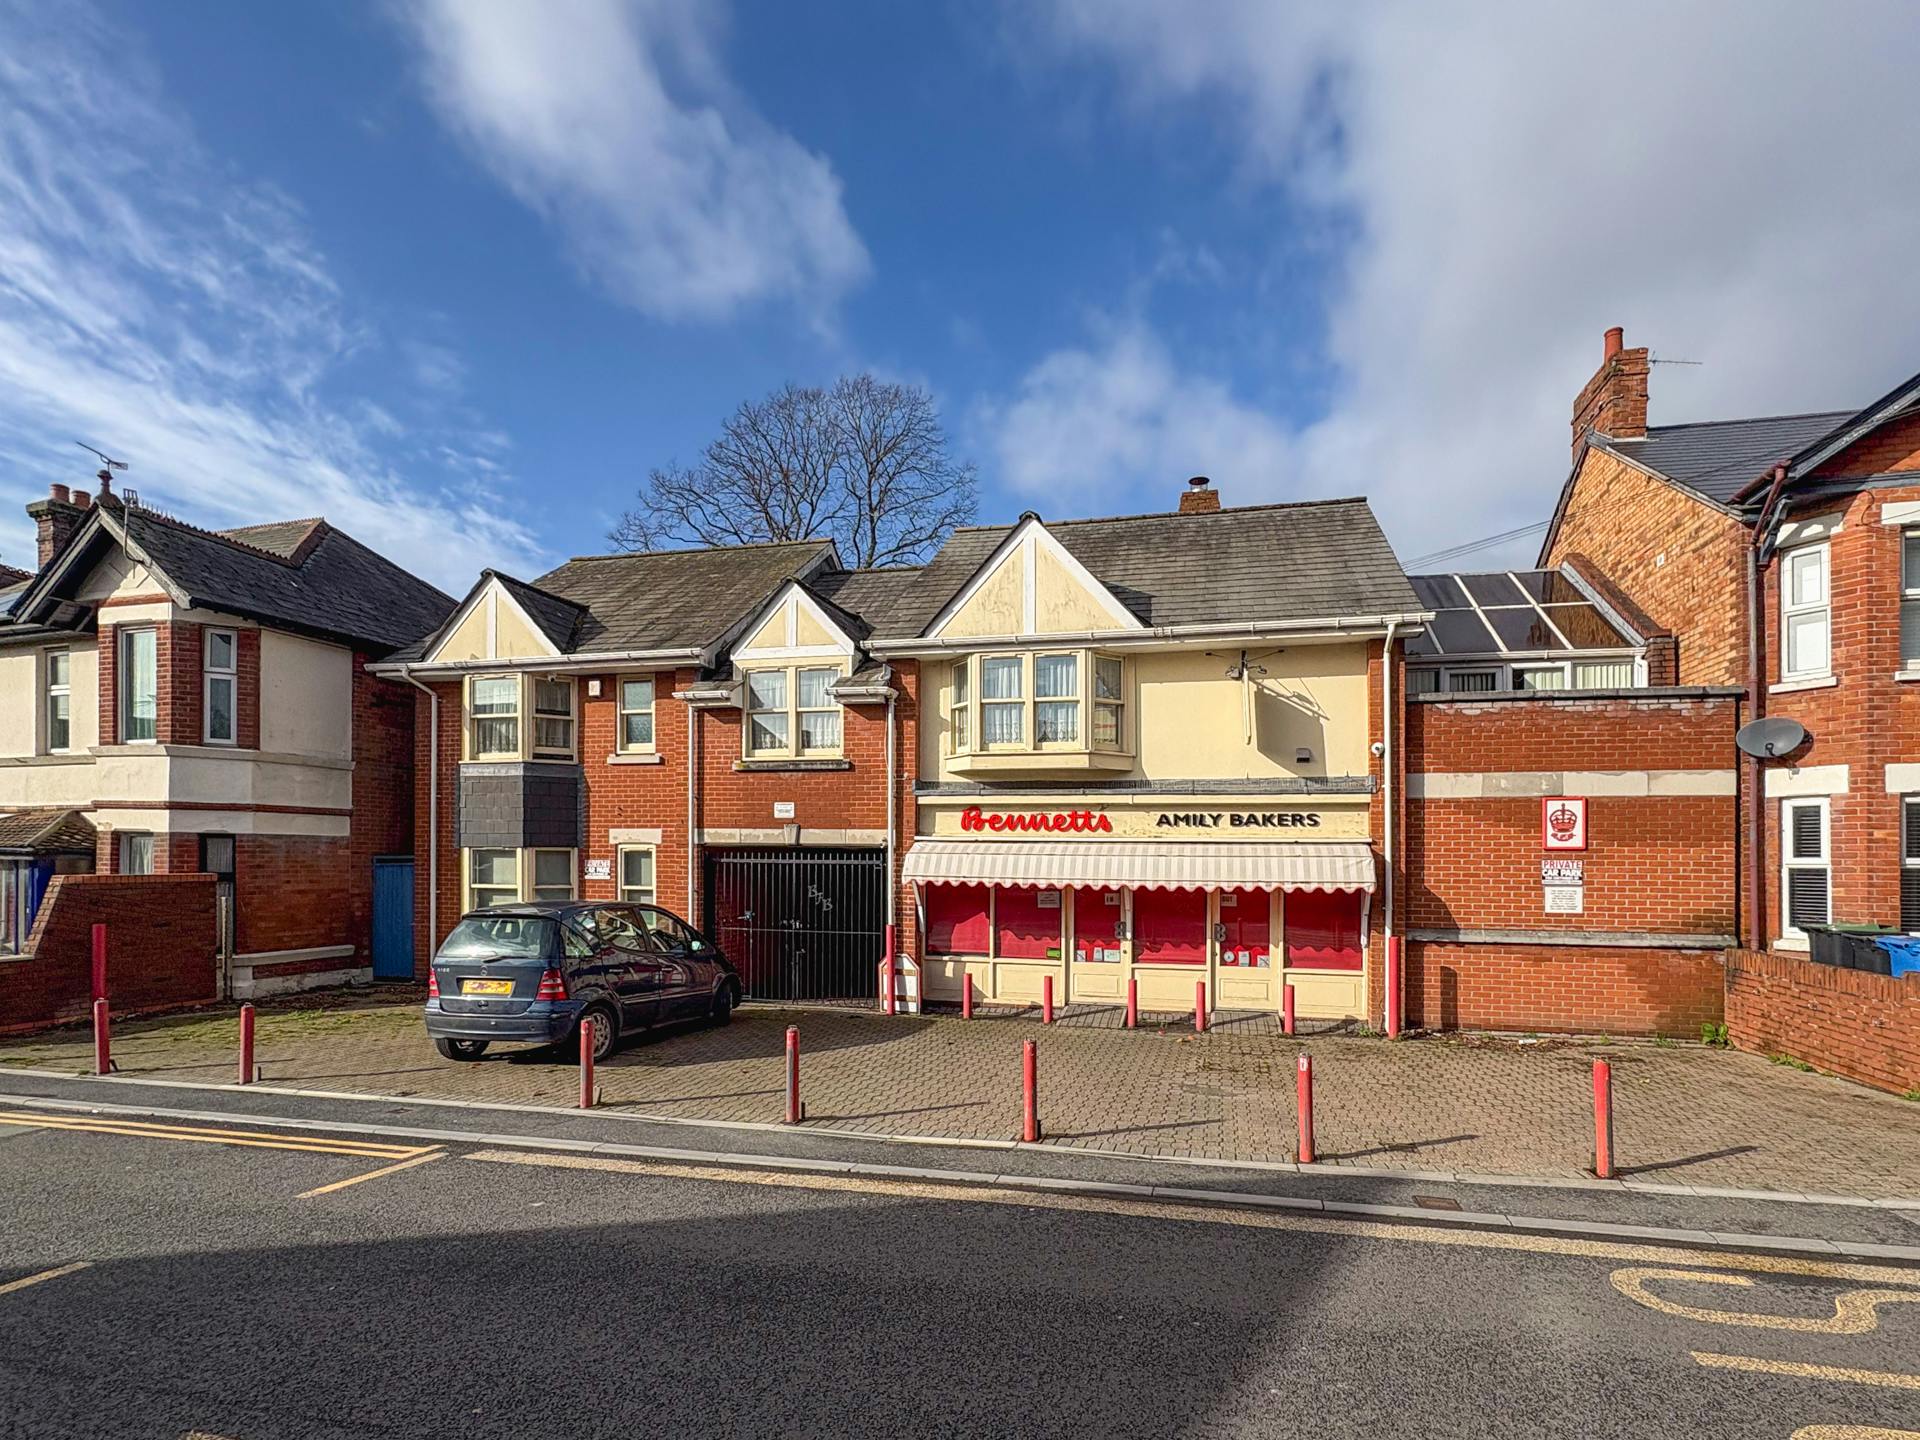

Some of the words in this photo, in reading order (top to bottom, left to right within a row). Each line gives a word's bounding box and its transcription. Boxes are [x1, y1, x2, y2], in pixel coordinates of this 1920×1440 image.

[961, 805, 1113, 832] Bennetts
[1156, 813, 1224, 828] AMILY
[1230, 813, 1321, 827] BAKERS
[1543, 860, 1581, 869] PRIVATE
[1542, 869, 1559, 877] CAR
[1560, 869, 1582, 877] PARK
